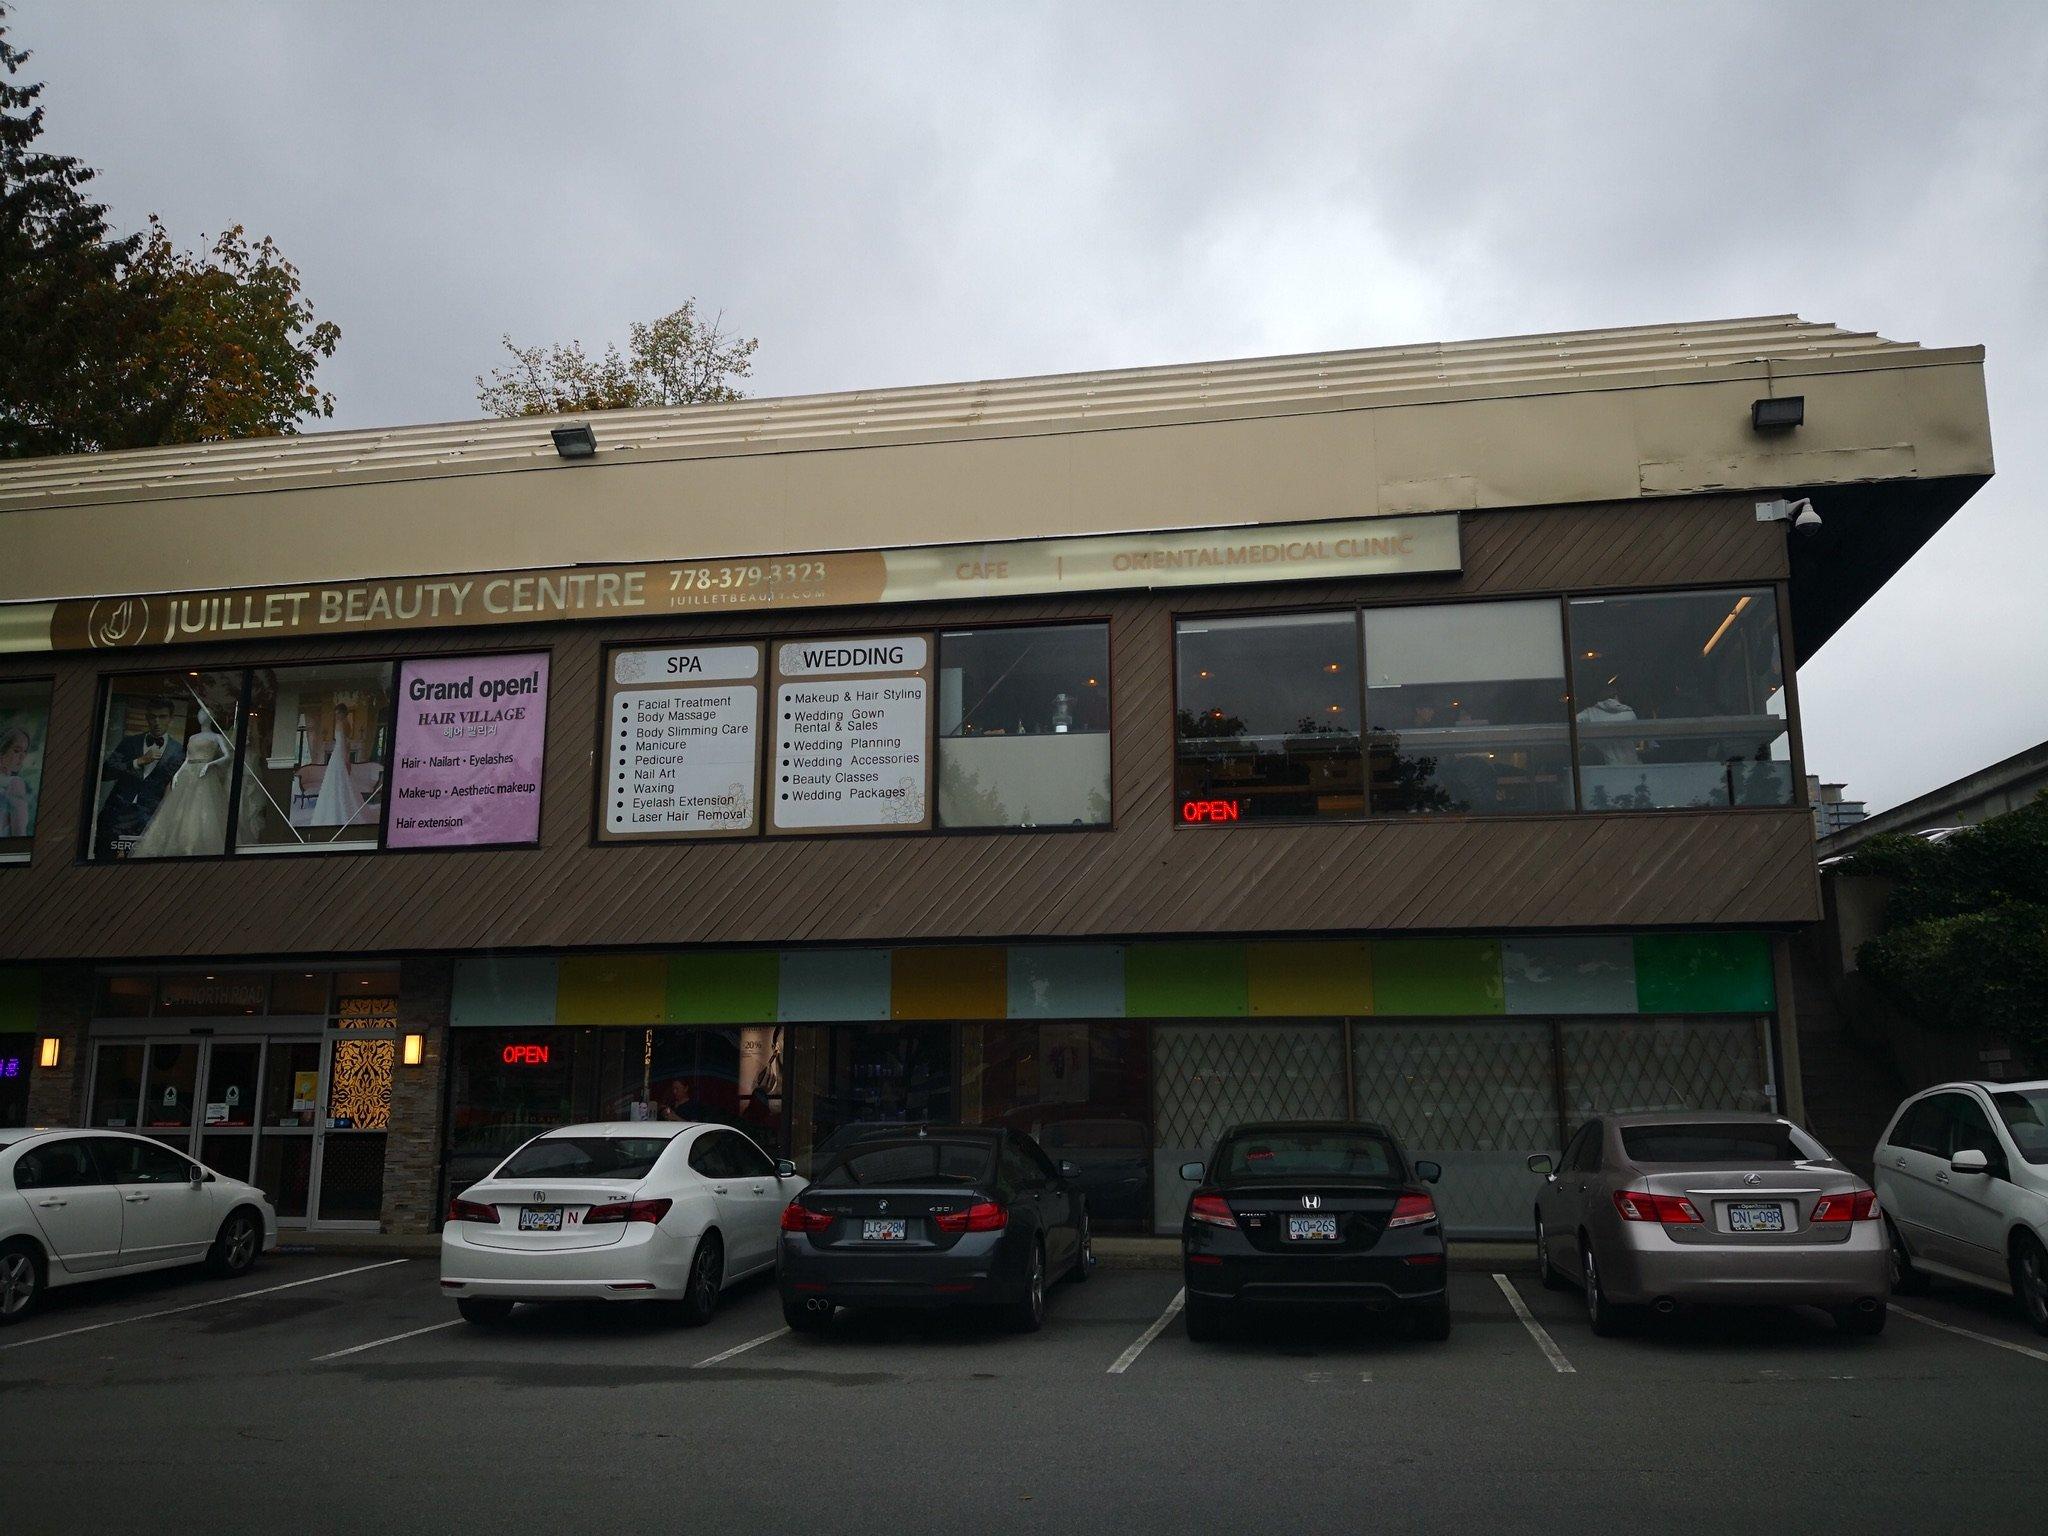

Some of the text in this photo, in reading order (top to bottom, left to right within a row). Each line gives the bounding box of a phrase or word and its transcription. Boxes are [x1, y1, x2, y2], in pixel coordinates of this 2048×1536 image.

[1112, 534, 1414, 571] ORIENTAL MEDICAL CLINIC
[670, 562, 826, 591] 778-379-3323
[955, 561, 1009, 581] CAFE
[163, 571, 646, 643] JUILLET BEAUTY CENTRE
[803, 646, 904, 668] WEDDING
[667, 655, 703, 674] SPA
[409, 671, 539, 702] Grand open!
[638, 696, 731, 710] Facial Treatment
[795, 688, 922, 704] Makeup & Hair Styling
[418, 707, 526, 726] HAIR VILLAGE
[637, 711, 716, 724] Body Massage
[794, 709, 884, 722] Wedding Gown
[636, 724, 749, 739] Body Slimming Care
[794, 721, 878, 733] Rental & Sales
[636, 741, 686, 752] Manicure
[794, 738, 901, 752] Wedding Planning
[401, 753, 514, 769] Hair Nailart Eyelashes
[635, 755, 684, 766] Pedicure
[794, 754, 920, 769] Wedding Accessories
[634, 769, 676, 780] Nail Art
[792, 771, 879, 785] Beauty Classes
[398, 782, 536, 800] Make-up Aesthetic makeup
[634, 784, 674, 795] Waxing
[792, 787, 906, 801] Wedding Packages
[632, 796, 734, 810] Eyelash Extension
[632, 809, 746, 822] Laser Hair Removal
[1183, 801, 1239, 821] OPEN
[396, 816, 463, 829] Hair extension
[502, 1044, 550, 1064] OPEN
[568, 1212, 578, 1224] N
